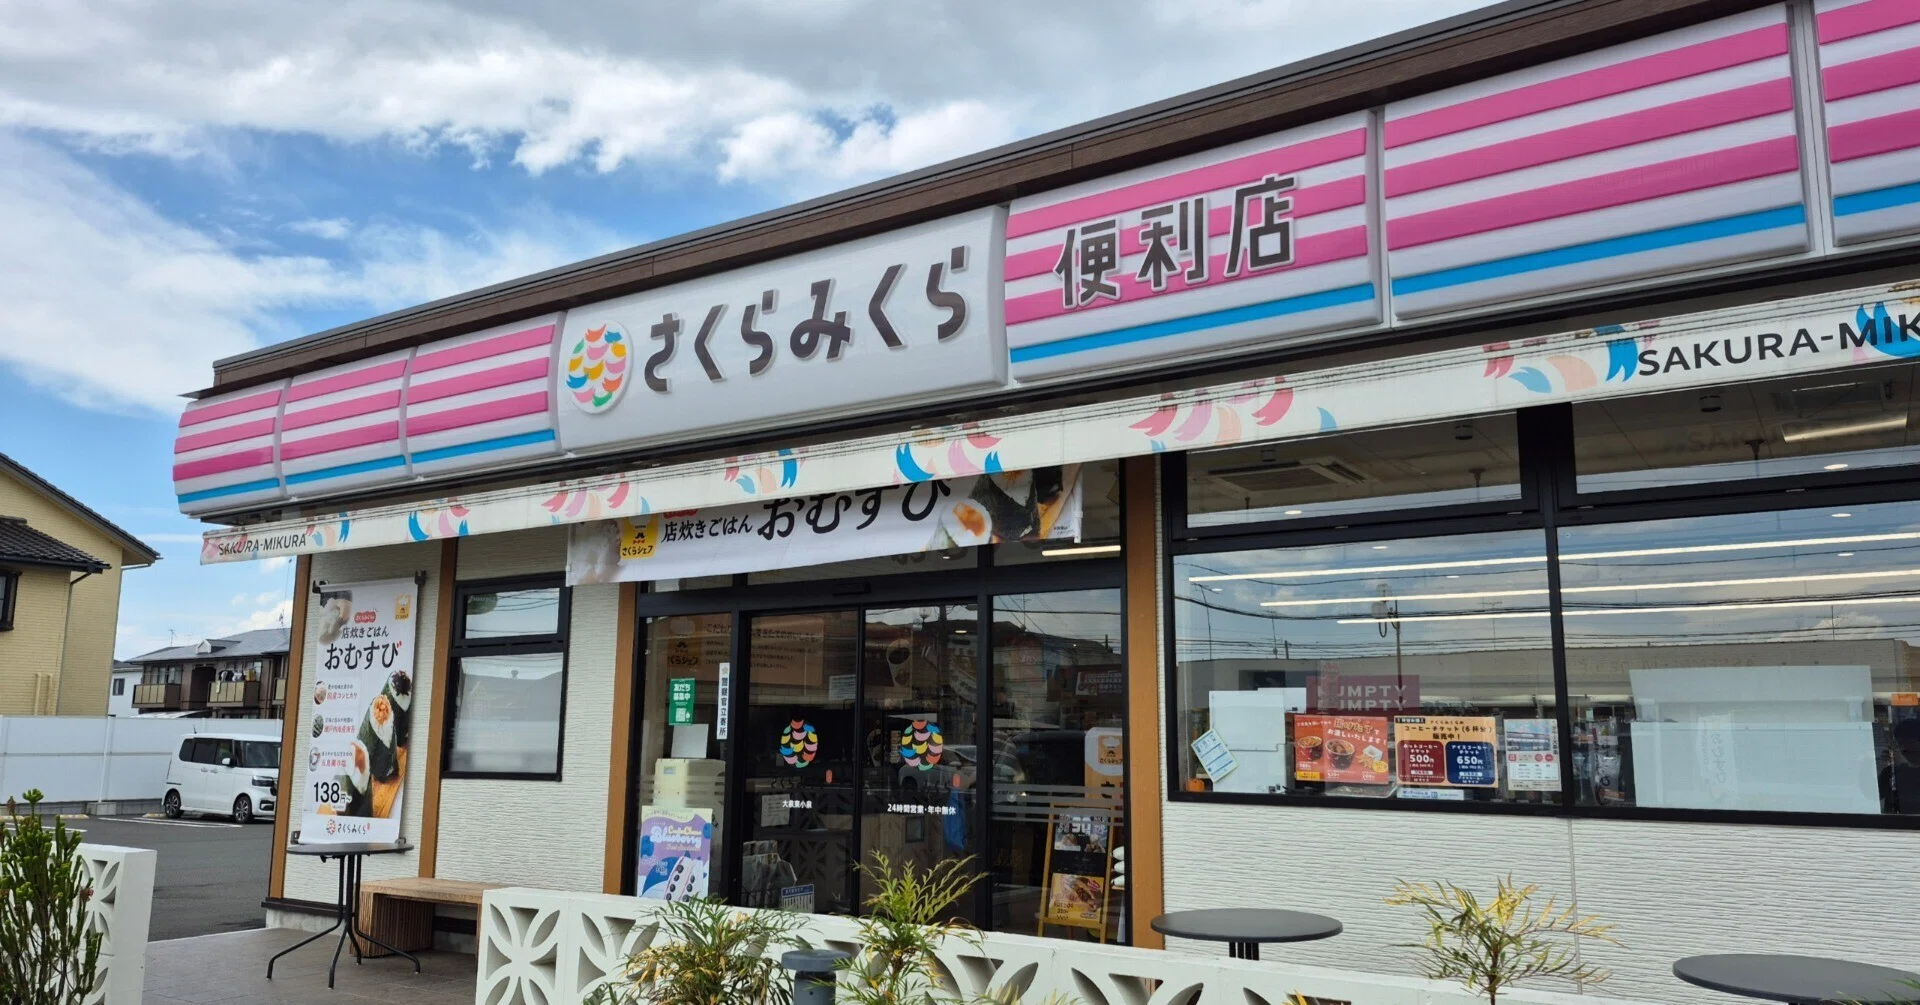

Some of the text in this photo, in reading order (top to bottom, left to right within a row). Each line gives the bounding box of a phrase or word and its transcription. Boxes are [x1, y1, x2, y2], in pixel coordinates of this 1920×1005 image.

[1053, 173, 1297, 310] 便利店
[643, 245, 968, 393] さくらみくら
[661, 514, 753, 543] 店炊きごはん
[218, 533, 307, 556] SAKURA-MIKURA
[622, 545, 653, 556] さくらシェフ
[341, 626, 389, 639] 店炊きごはん
[324, 640, 402, 671] おむすび
[673, 683, 691, 692] 友だち
[673, 692, 691, 701] 募集中
[718, 677, 729, 736] 警察官立寄所
[1409, 754, 1435, 763] 500円
[1456, 756, 1483, 765] 650円
[782, 800, 812, 809] 大泉東小泉
[887, 803, 957, 815] 24時間営業・年中無休
[337, 823, 366, 834] さくらみくら
